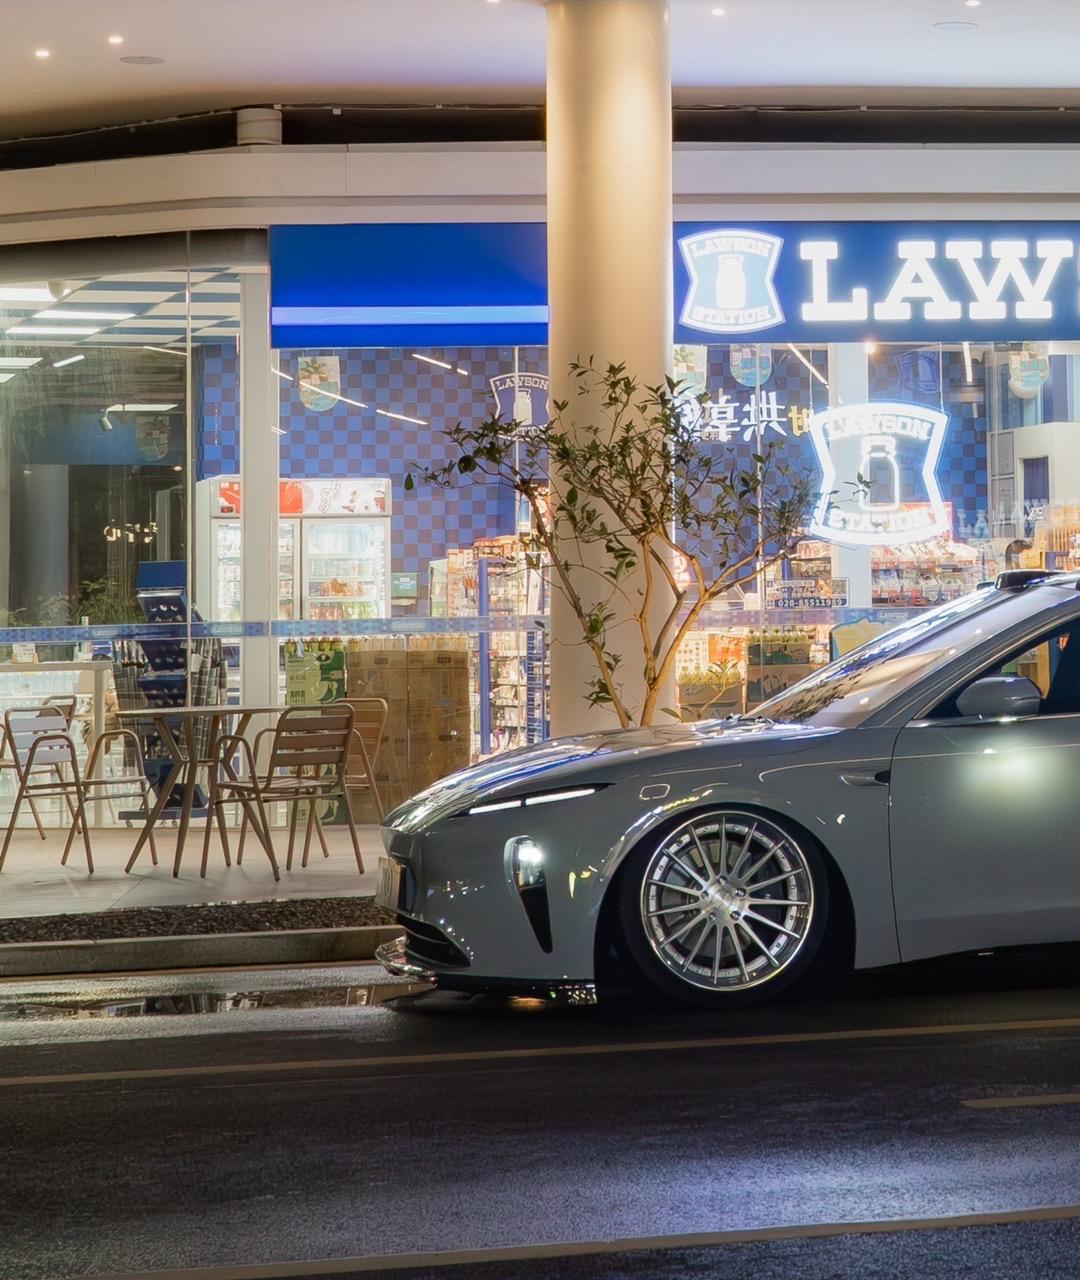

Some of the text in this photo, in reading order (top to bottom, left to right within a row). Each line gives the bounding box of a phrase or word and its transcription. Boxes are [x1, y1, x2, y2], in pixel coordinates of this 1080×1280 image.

[690, 236, 773, 257] LAWSON
[692, 305, 771, 324] STATION
[825, 413, 933, 441] LAWSON
